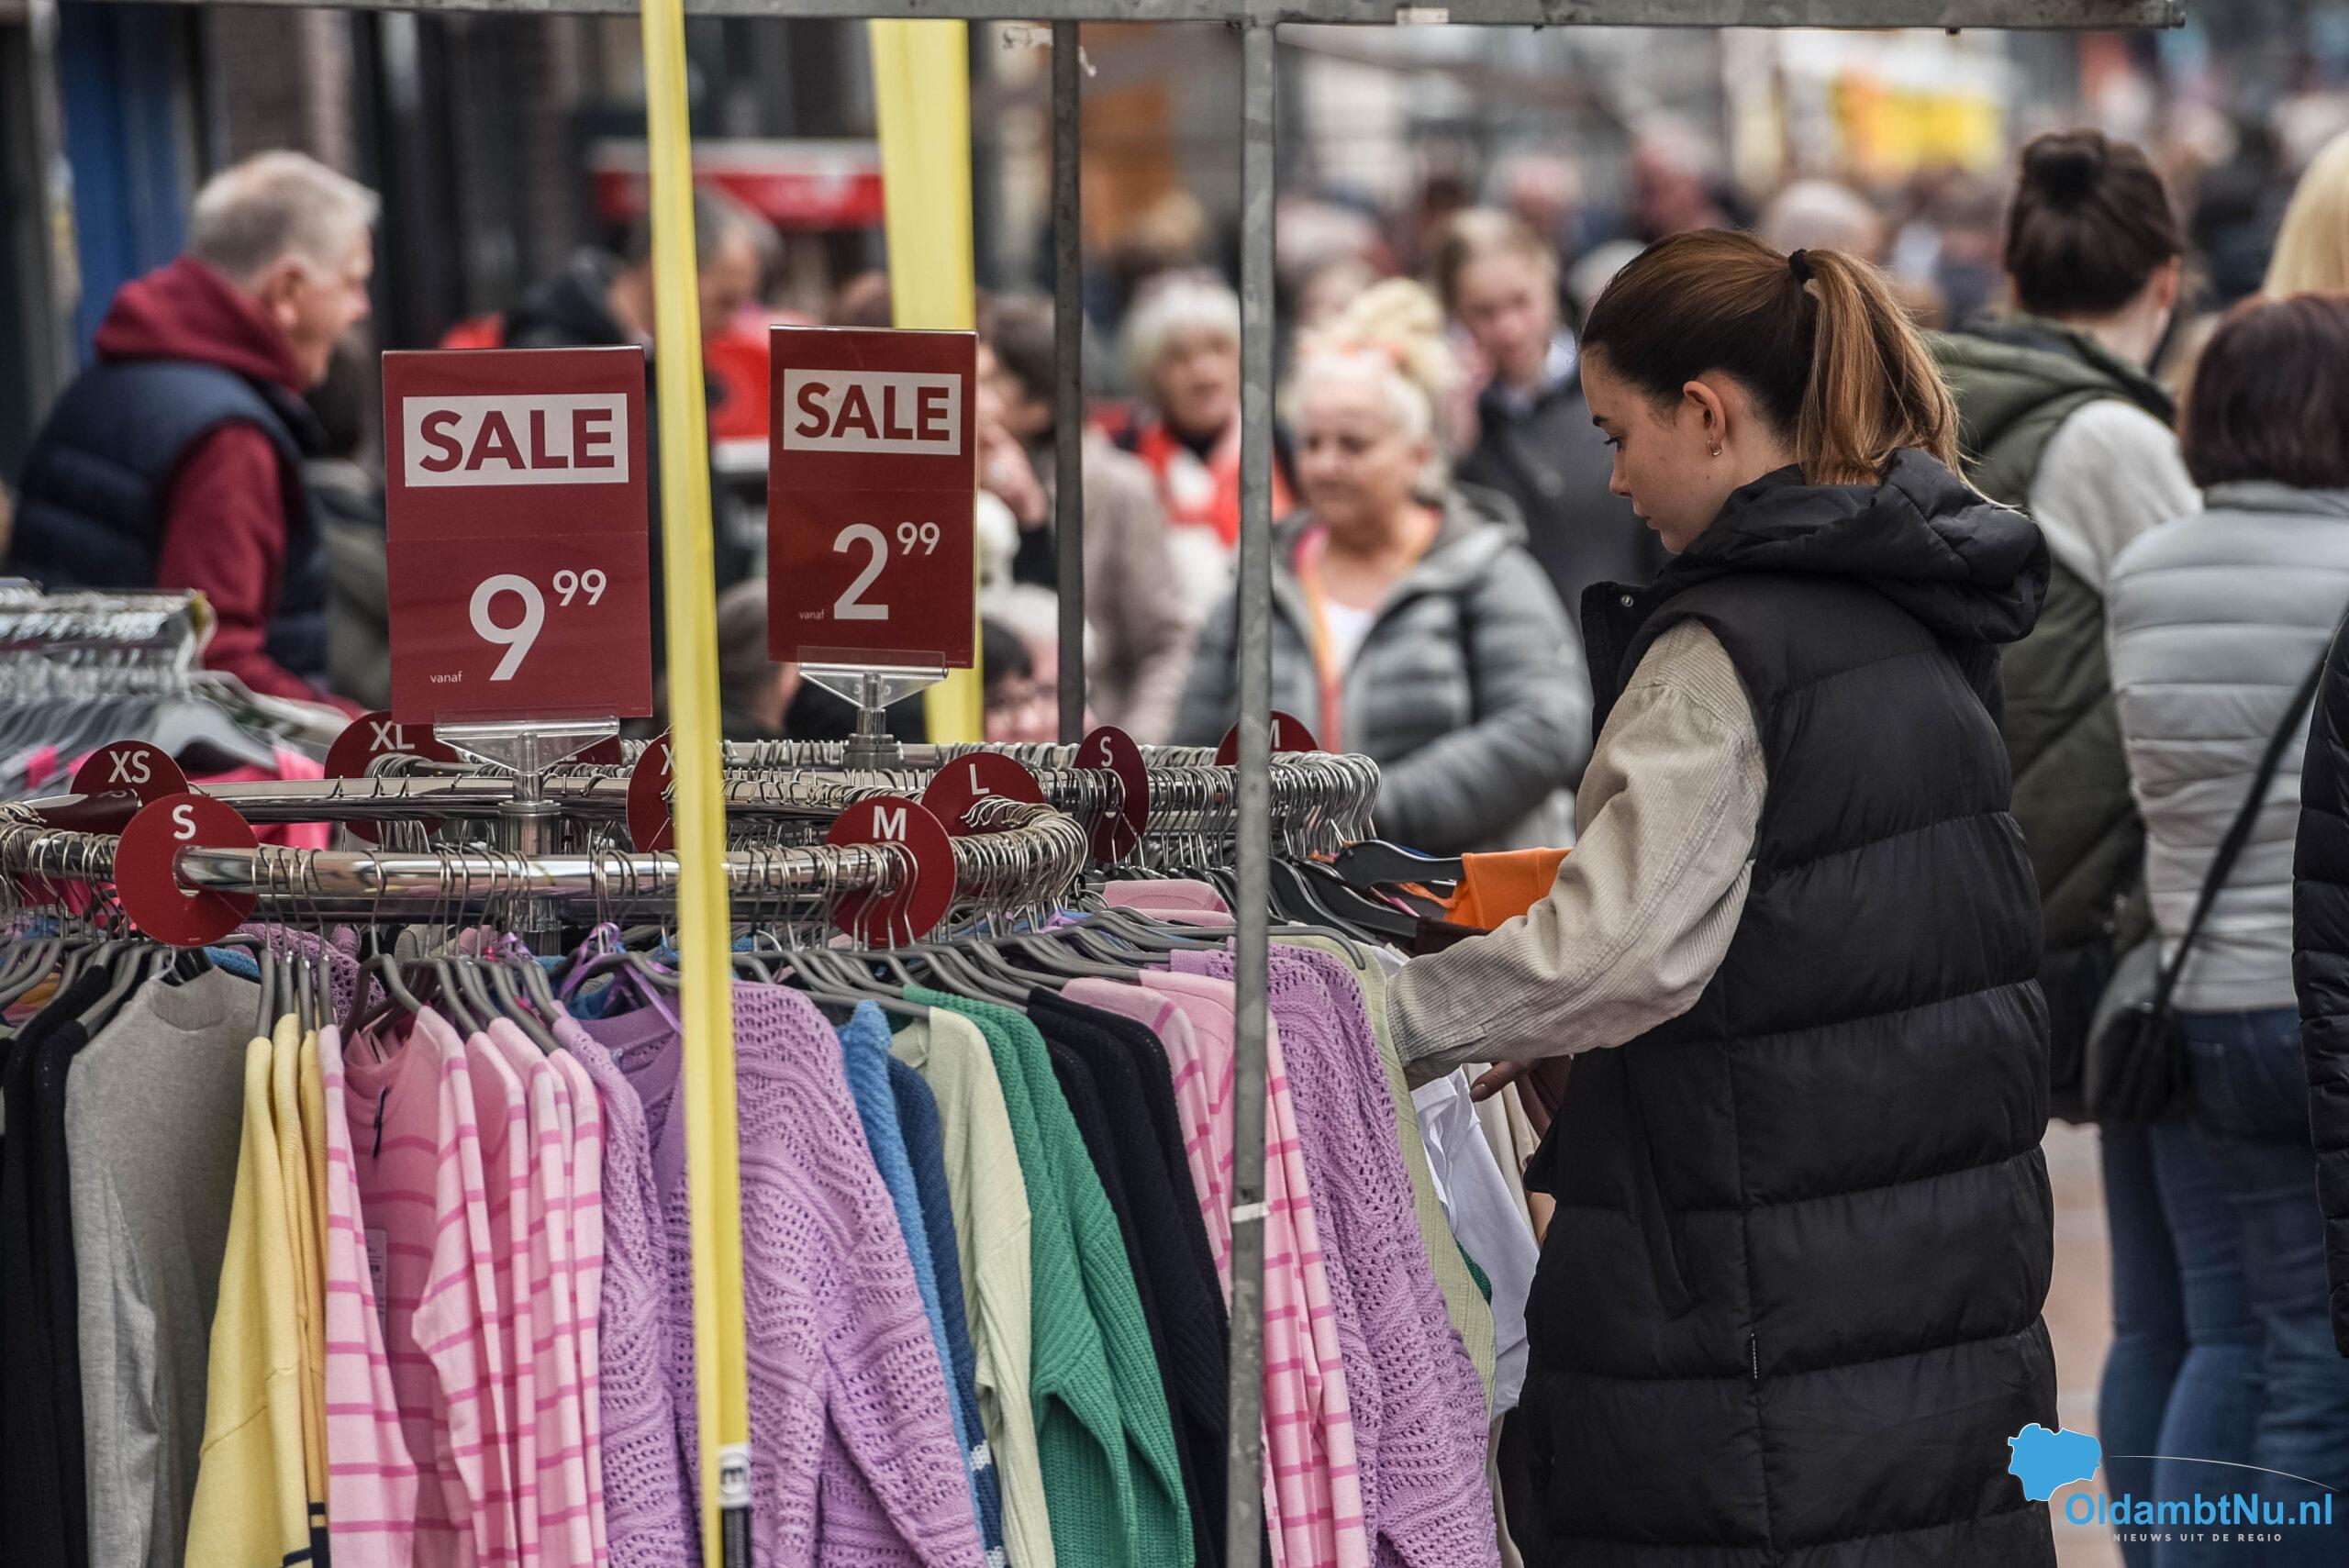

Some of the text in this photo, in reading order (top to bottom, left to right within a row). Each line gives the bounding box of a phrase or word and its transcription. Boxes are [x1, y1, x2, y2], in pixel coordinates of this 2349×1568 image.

[796, 383, 950, 441] SALE
[419, 409, 615, 473] SALE
[798, 609, 825, 620] vanaf
[429, 671, 463, 684] vanaf
[369, 721, 415, 751] XL
[1100, 736, 1113, 767] S
[107, 750, 151, 784] XS
[969, 762, 990, 796] L
[173, 804, 196, 840] S
[873, 805, 907, 841] M
